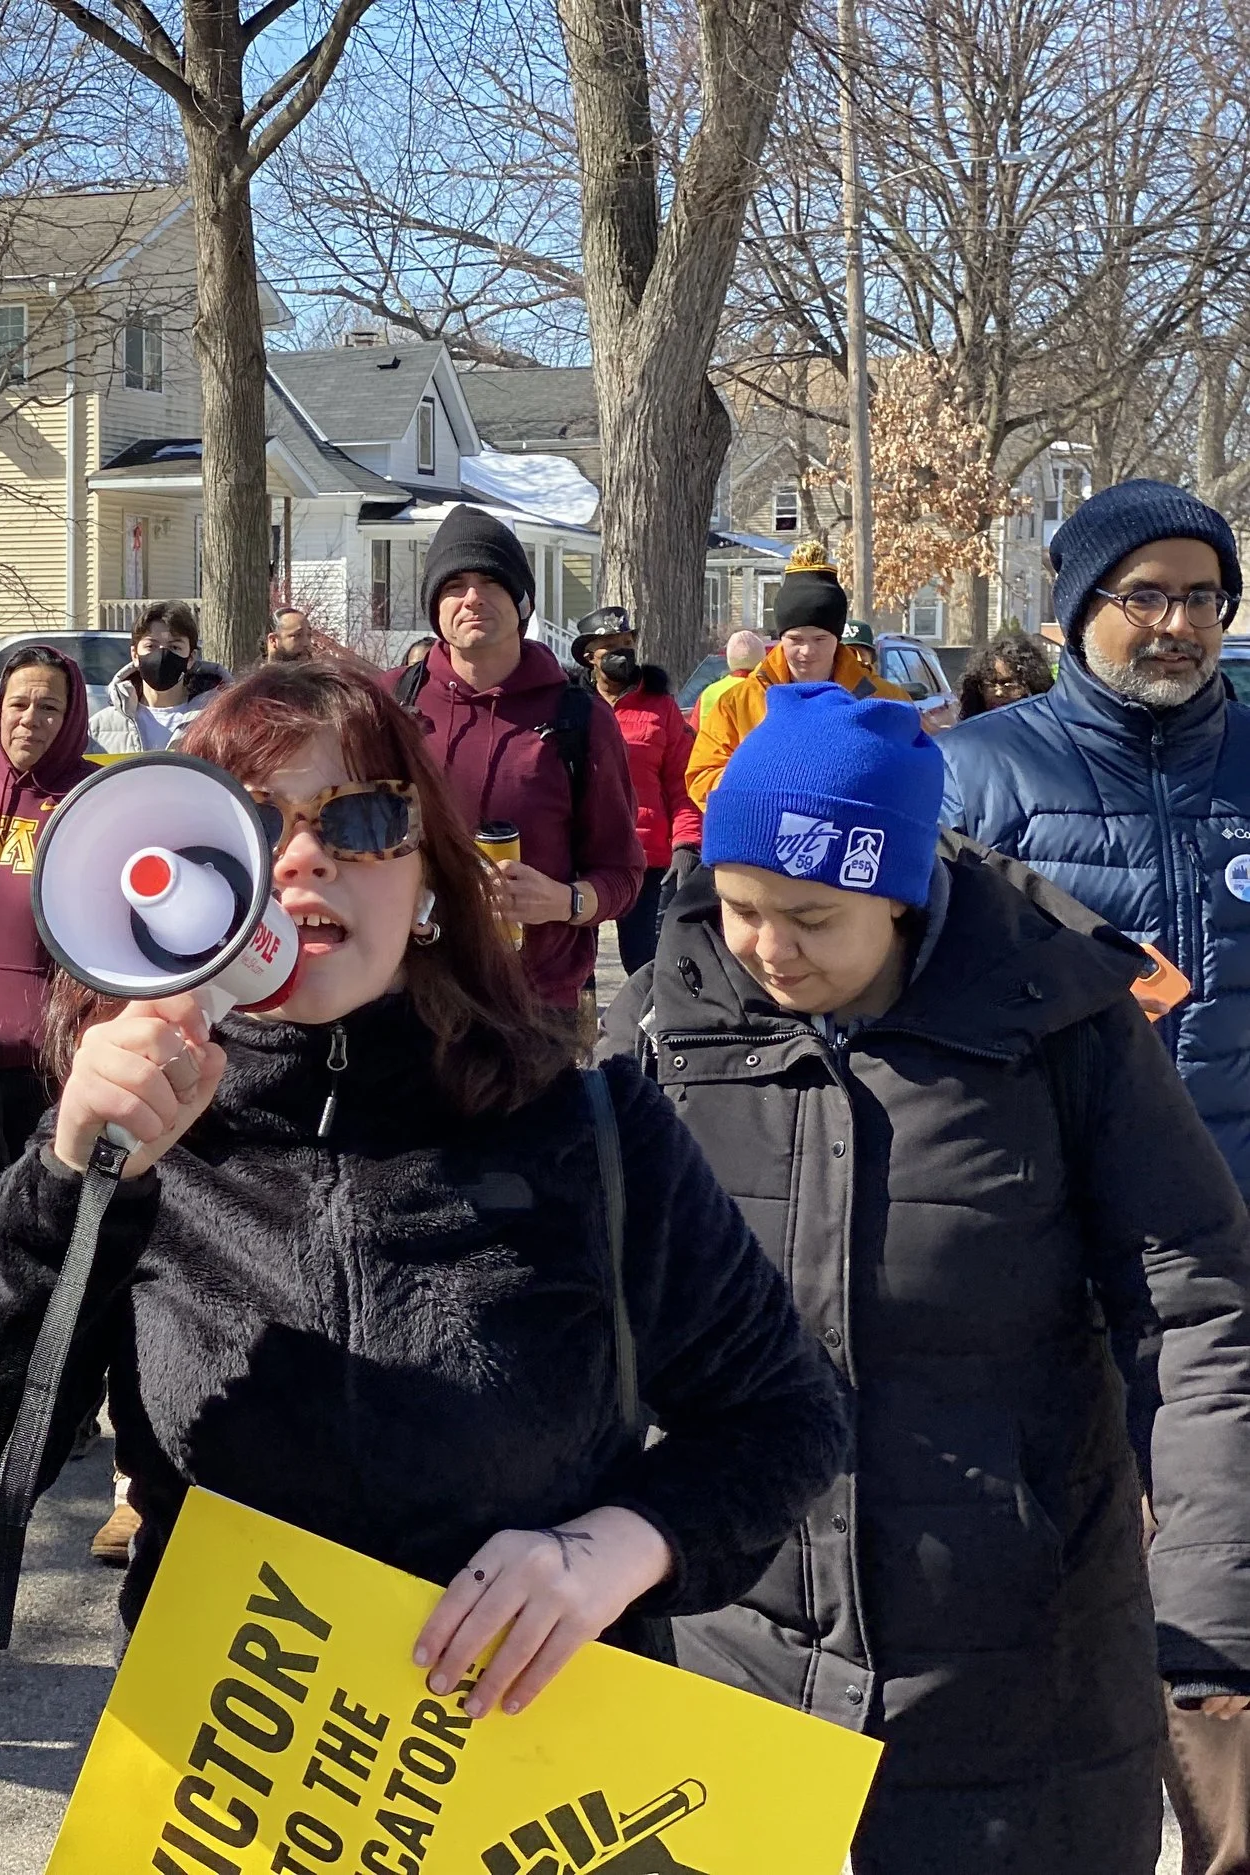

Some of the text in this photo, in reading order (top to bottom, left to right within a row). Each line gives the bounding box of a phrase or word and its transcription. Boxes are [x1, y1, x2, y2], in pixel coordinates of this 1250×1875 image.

[795, 854, 813, 870] 59
[851, 859, 871, 873] esp
[271, 1687, 391, 1875] TO THE
